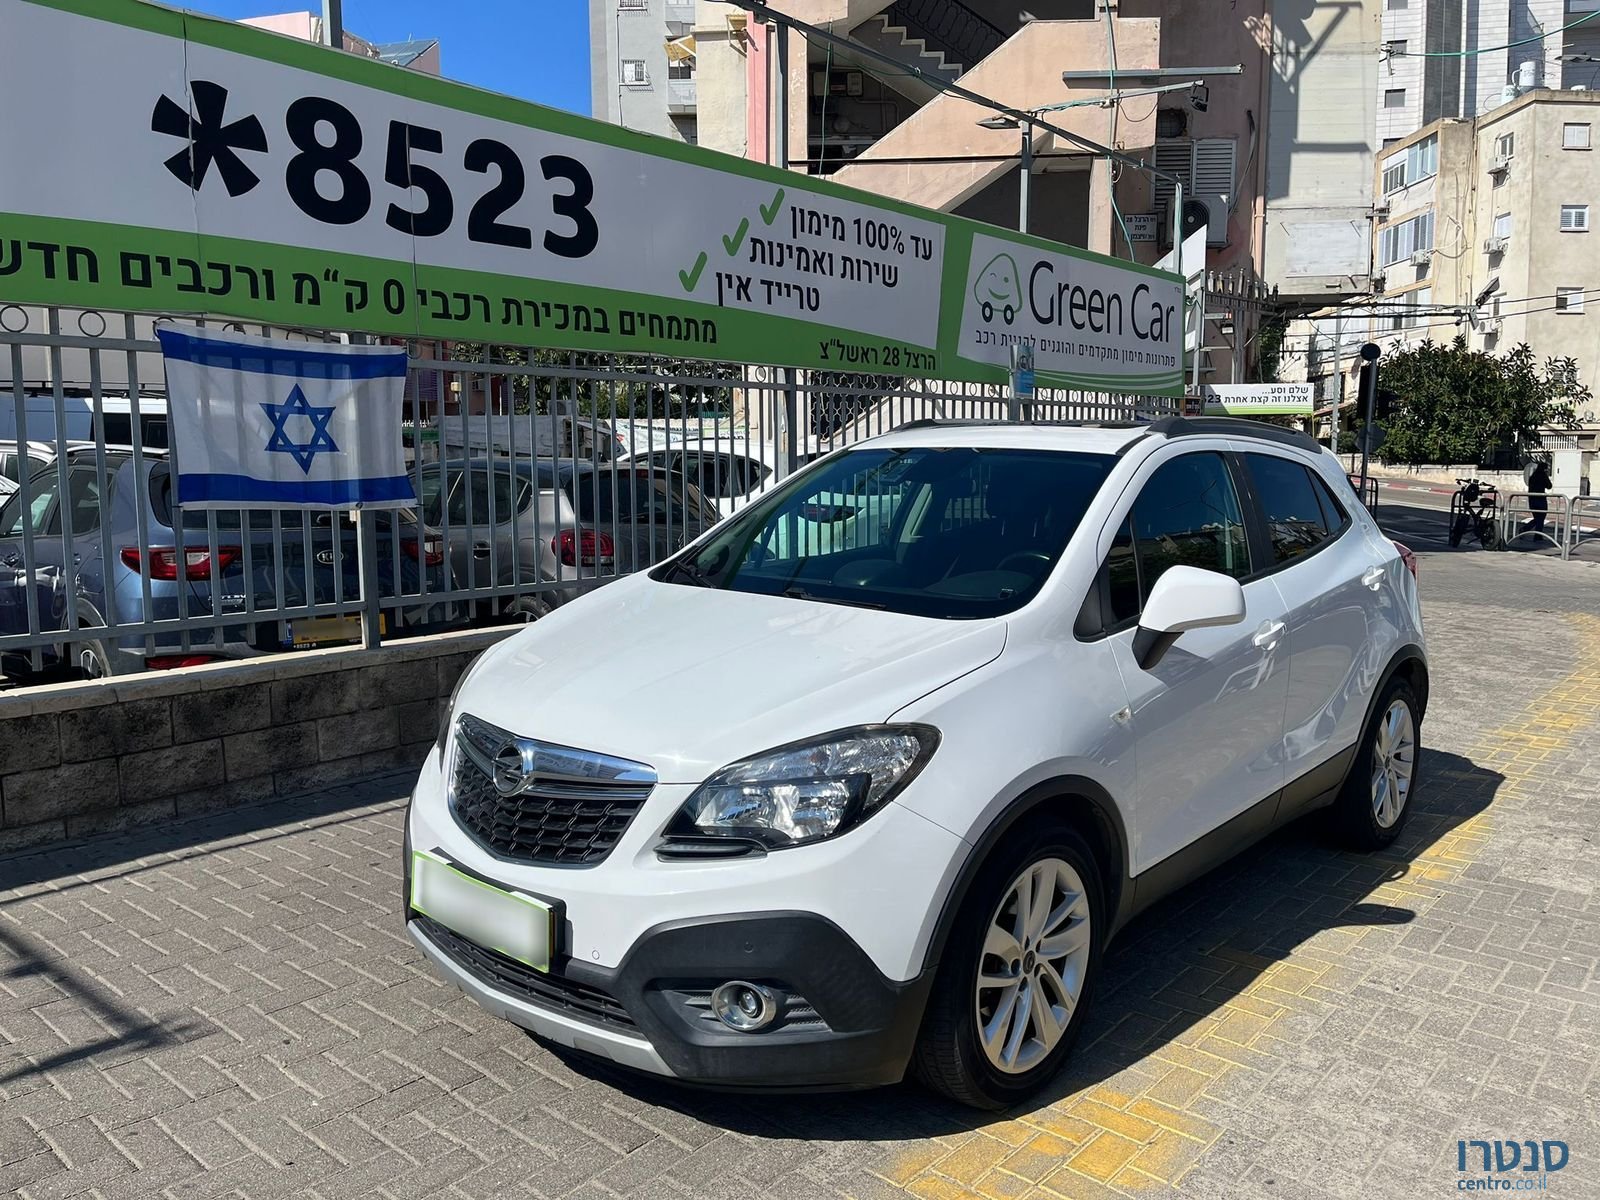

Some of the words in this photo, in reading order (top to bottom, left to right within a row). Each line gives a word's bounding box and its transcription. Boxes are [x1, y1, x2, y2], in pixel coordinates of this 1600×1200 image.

[791, 206, 846, 242] מימון
[853, 217, 905, 255] 100%
[749, 237, 834, 277] ואמינות
[910, 235, 933, 261] עד
[119, 251, 275, 301] ורכבים
[840, 254, 899, 288] שירות
[292, 267, 368, 313] ק"מ
[383, 278, 405, 315] 0
[716, 272, 752, 307] אין
[760, 278, 820, 312] טרייד
[1029, 260, 1124, 336] Green
[1130, 283, 1175, 343] Car
[416, 288, 491, 322] רכבי
[501, 297, 610, 334] במכירת
[619, 310, 717, 344] מתמחים
[975, 329, 996, 345] רכב
[819, 338, 878, 365] ראשל"צ
[882, 346, 900, 367] 28
[904, 348, 936, 371] הרצל
[1040, 339, 1075, 356] והוגנים
[1079, 341, 1119, 362] מתקדמים
[1121, 349, 1143, 365] מימון
[1145, 351, 1176, 367] פתרונות
[1204, 394, 1222, 404] 23
[1224, 395, 1248, 403] אחרת
[1250, 395, 1269, 405] קצת
[1271, 395, 1281, 403] זה
[1283, 394, 1308, 403] אצלנו
[1288, 385, 1309, 394] שלם
